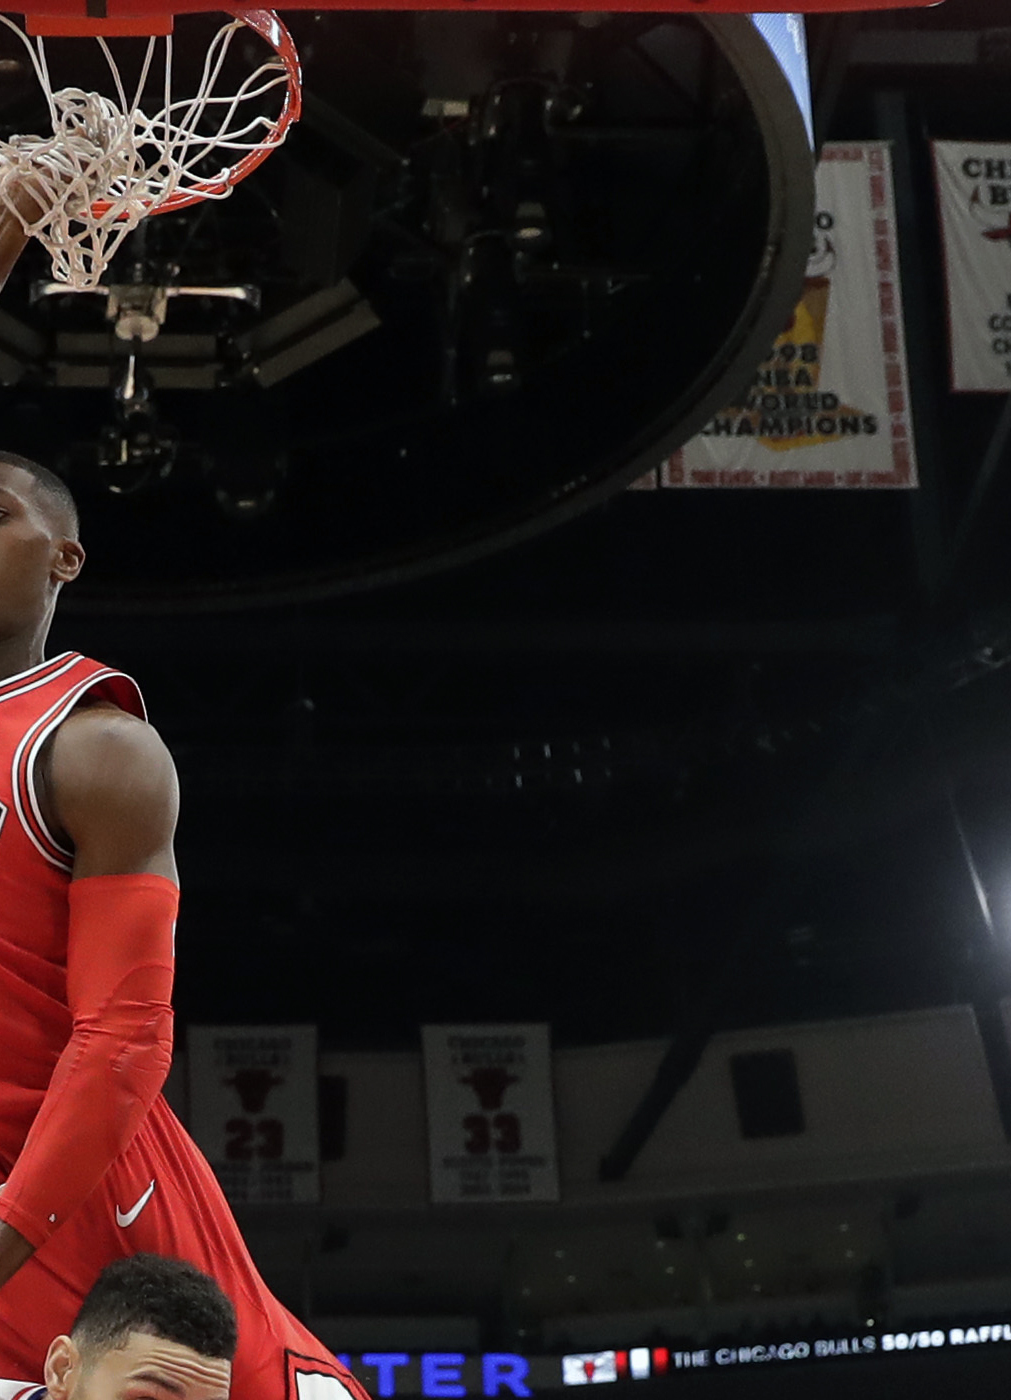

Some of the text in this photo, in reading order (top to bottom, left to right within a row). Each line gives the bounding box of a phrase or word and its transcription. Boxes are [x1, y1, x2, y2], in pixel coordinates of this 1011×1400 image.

[715, 1342, 811, 1366] CHICAGO
[815, 1335, 877, 1357] BULLS
[882, 1329, 946, 1352] 50/50
[360, 1352, 534, 1398] TER
